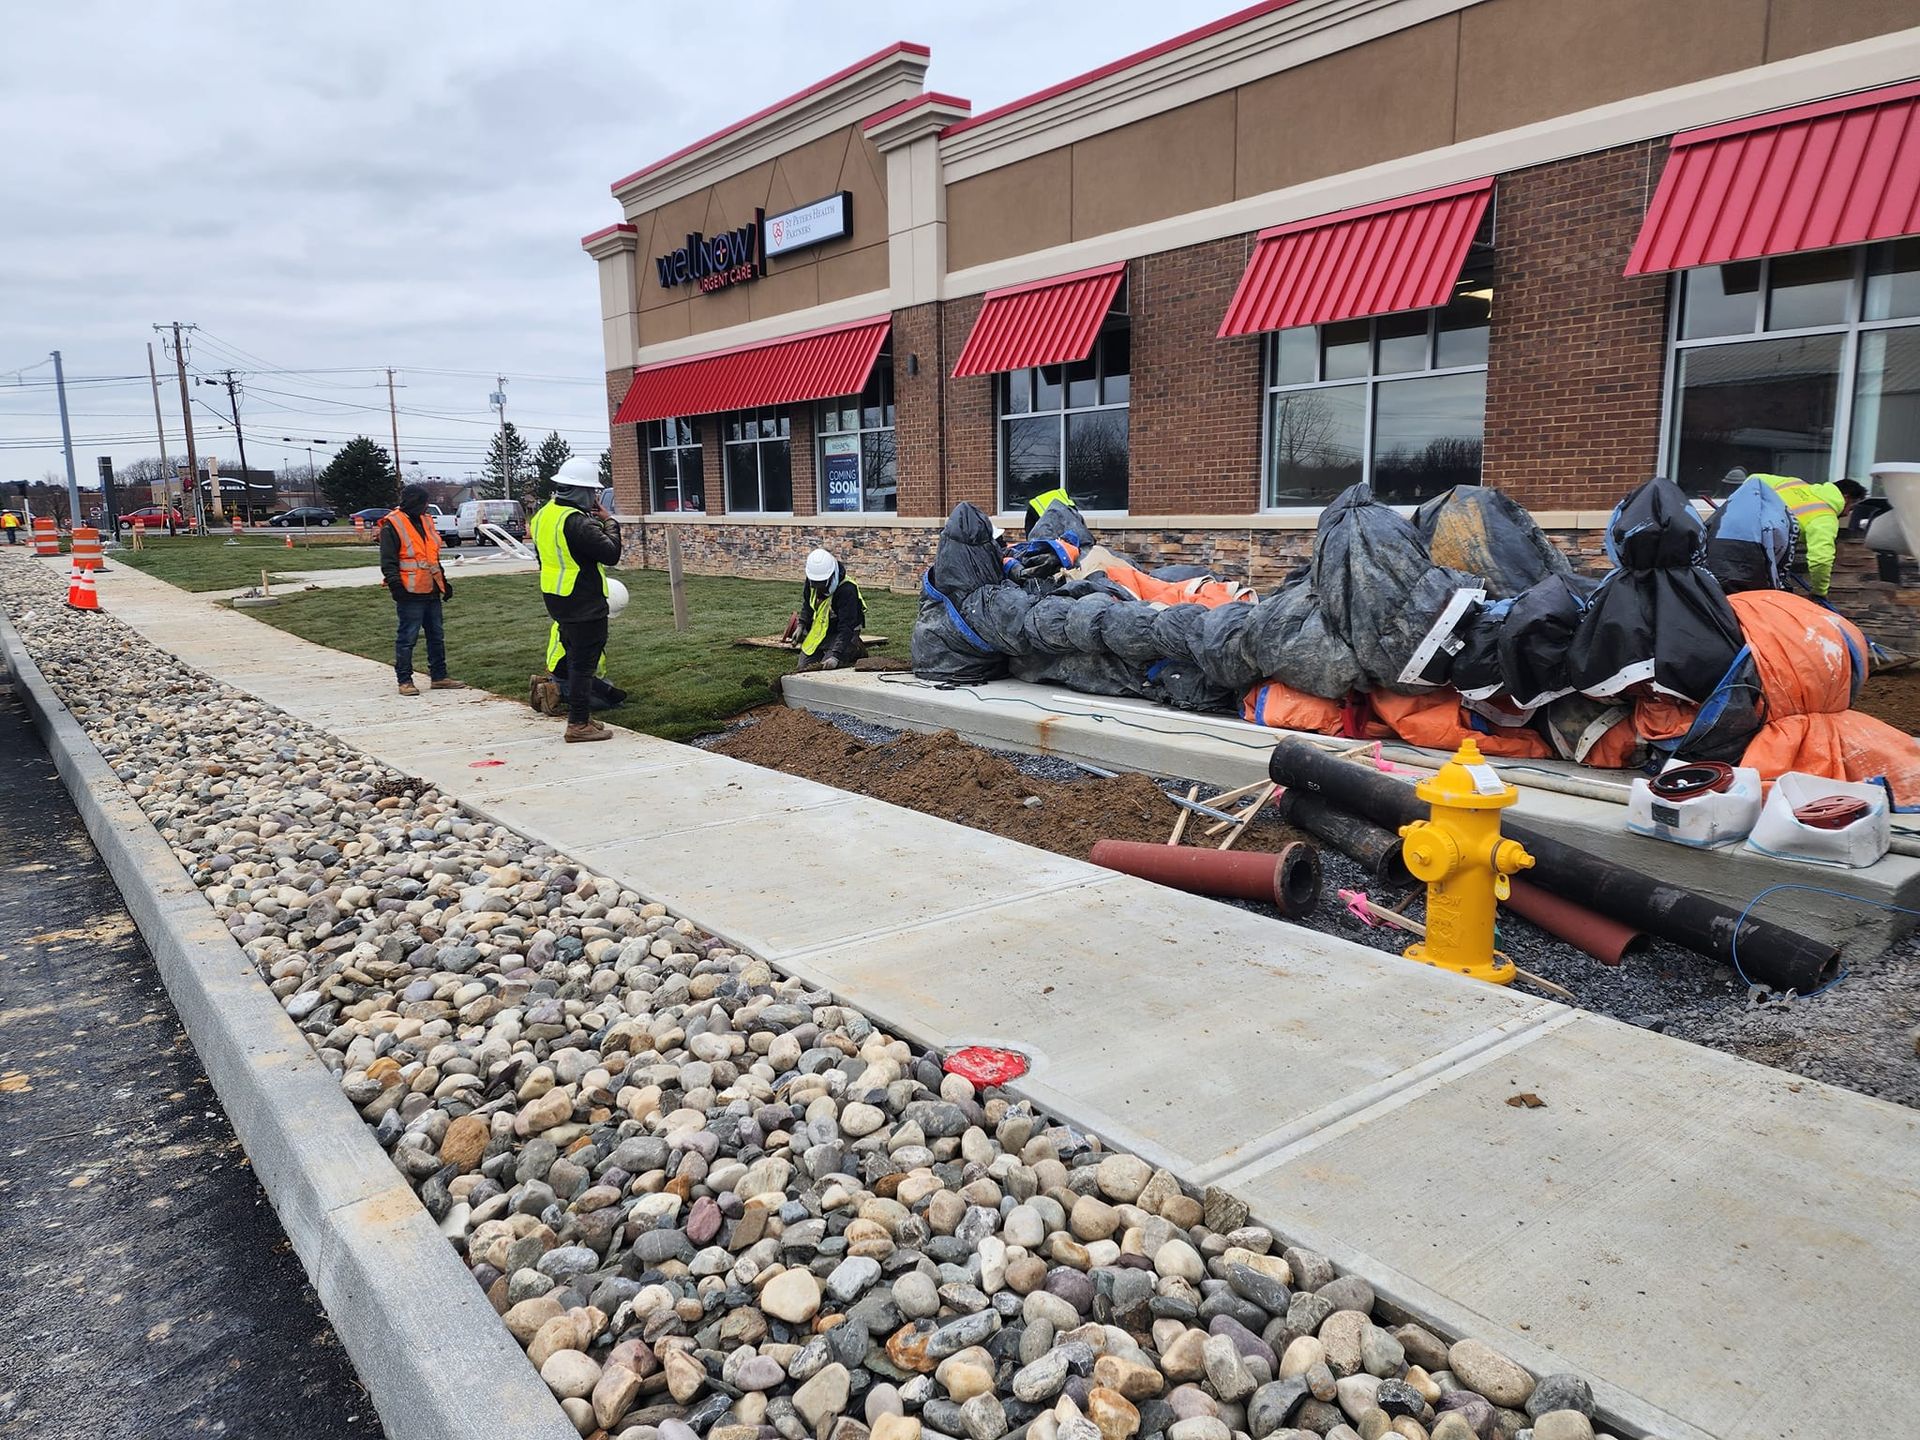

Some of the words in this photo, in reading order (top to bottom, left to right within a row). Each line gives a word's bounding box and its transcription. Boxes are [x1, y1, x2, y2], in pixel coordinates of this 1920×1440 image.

[699, 271, 728, 293] URGENT
[730, 264, 752, 283] CARE
[829, 470, 856, 480] COMING
[829, 481, 857, 494] SOON
